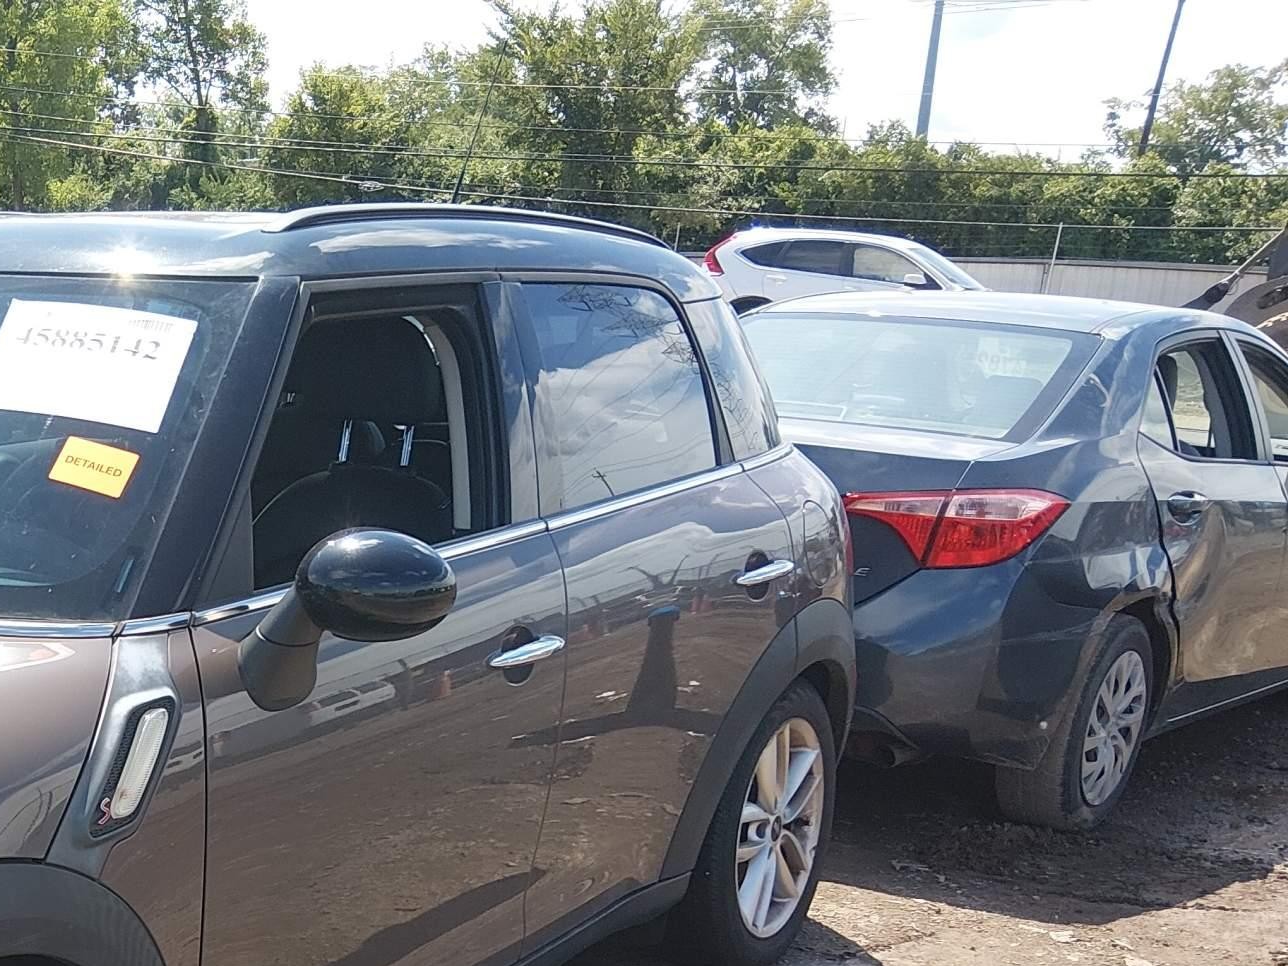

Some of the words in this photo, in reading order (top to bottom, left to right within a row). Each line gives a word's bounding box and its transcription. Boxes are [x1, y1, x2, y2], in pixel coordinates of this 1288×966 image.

[16, 326, 161, 361] 45885142
[64, 454, 123, 479] DETAILED
[98, 796, 112, 826] S
